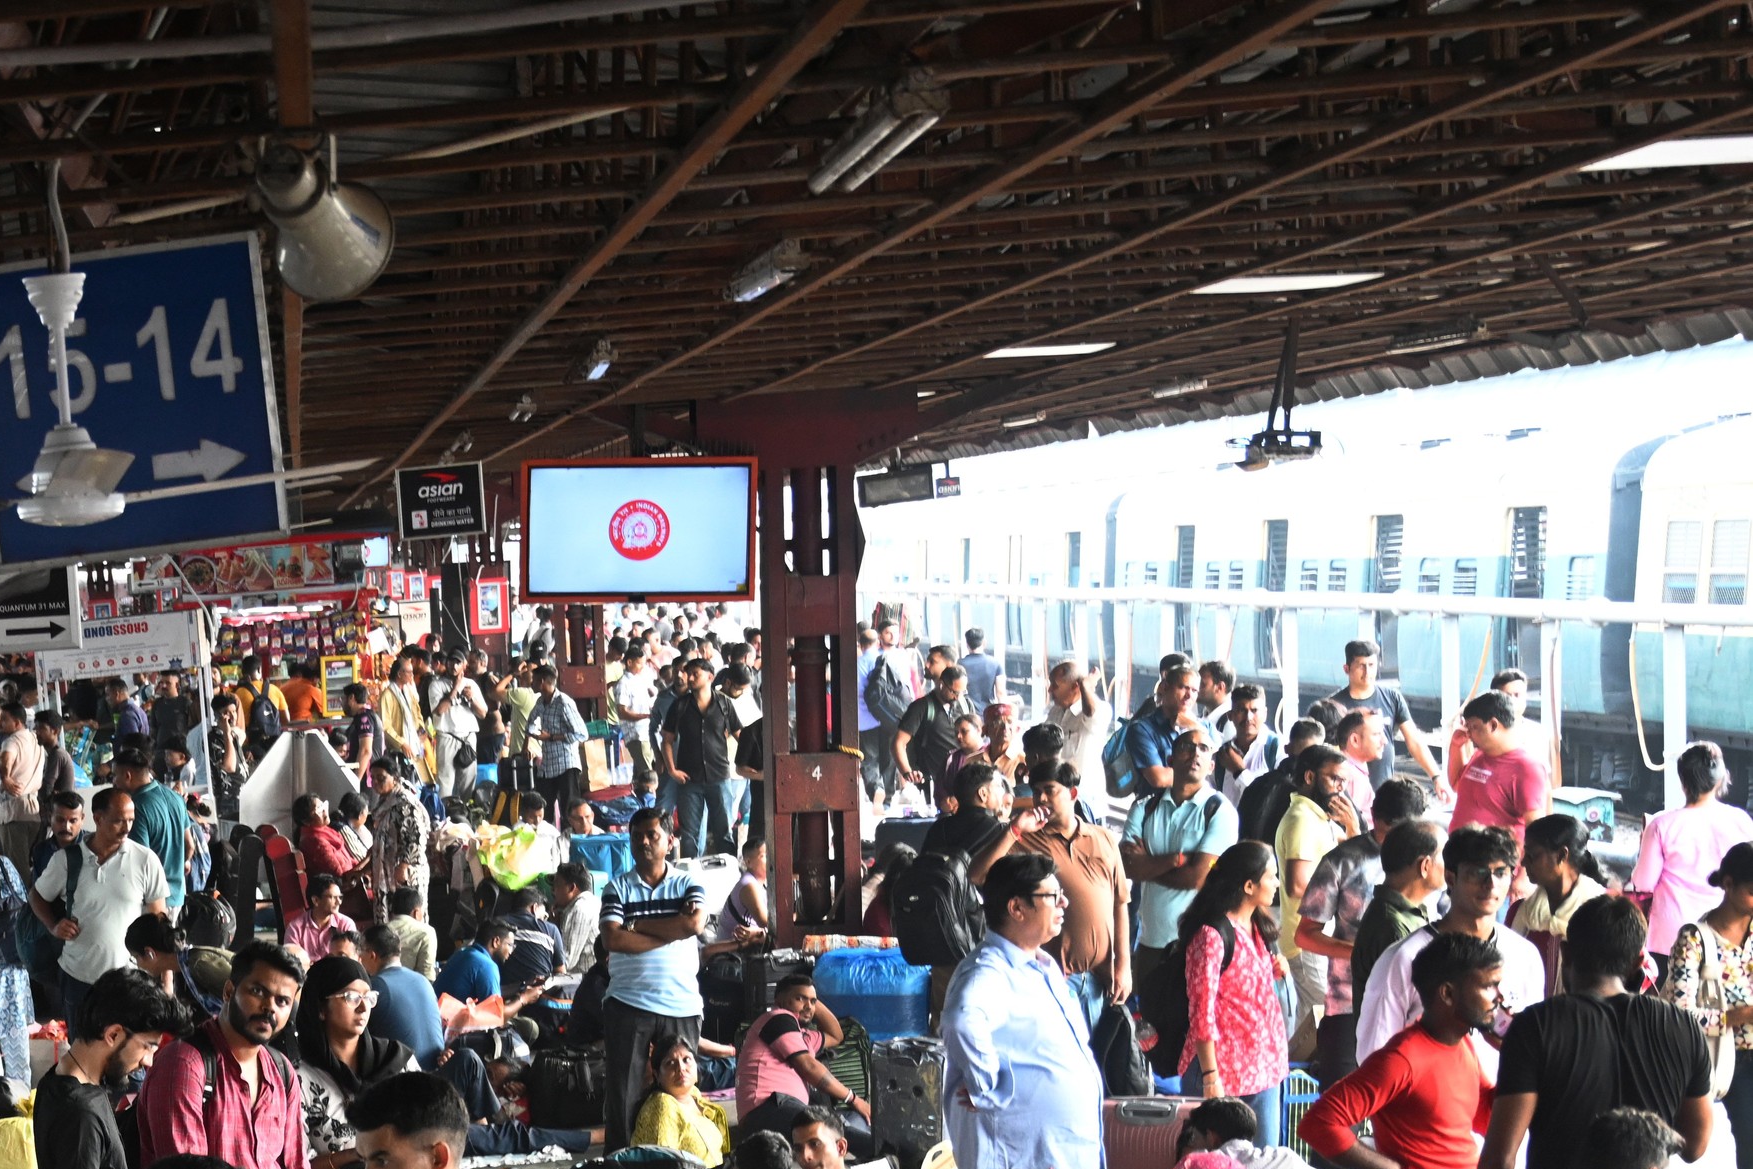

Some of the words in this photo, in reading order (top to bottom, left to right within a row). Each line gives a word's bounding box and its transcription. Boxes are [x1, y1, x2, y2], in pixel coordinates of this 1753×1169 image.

[418, 482, 463, 499] asian
[430, 520, 455, 528] DRINKING
[456, 517, 475, 526] WATER
[0, 603, 37, 613] QUANTUM
[38, 603, 47, 611] 31
[48, 601, 67, 610] MAX
[83, 621, 149, 638] CROSSBOND
[811, 765, 823, 781] 4
